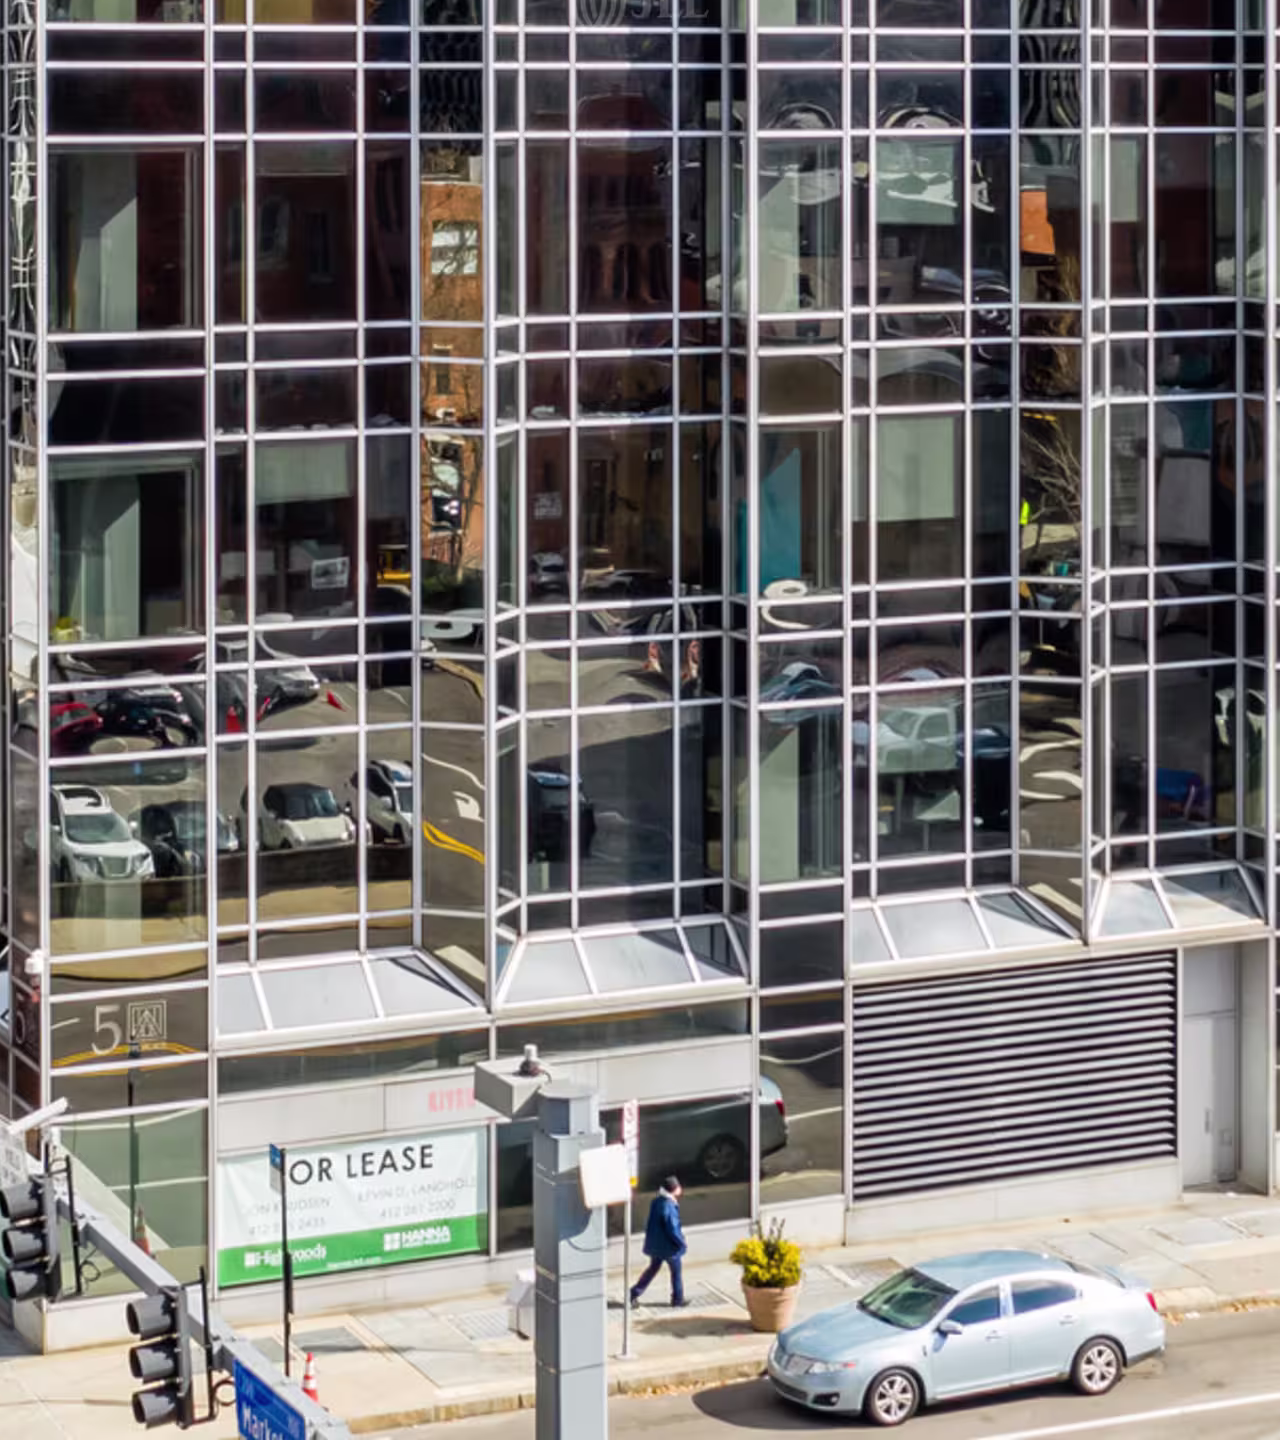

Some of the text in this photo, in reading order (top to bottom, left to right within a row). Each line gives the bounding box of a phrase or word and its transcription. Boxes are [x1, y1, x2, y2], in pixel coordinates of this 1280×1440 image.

[91, 1004, 122, 1056] 5
[289, 1158, 333, 1185] OR
[346, 1143, 435, 1179] LEASE
